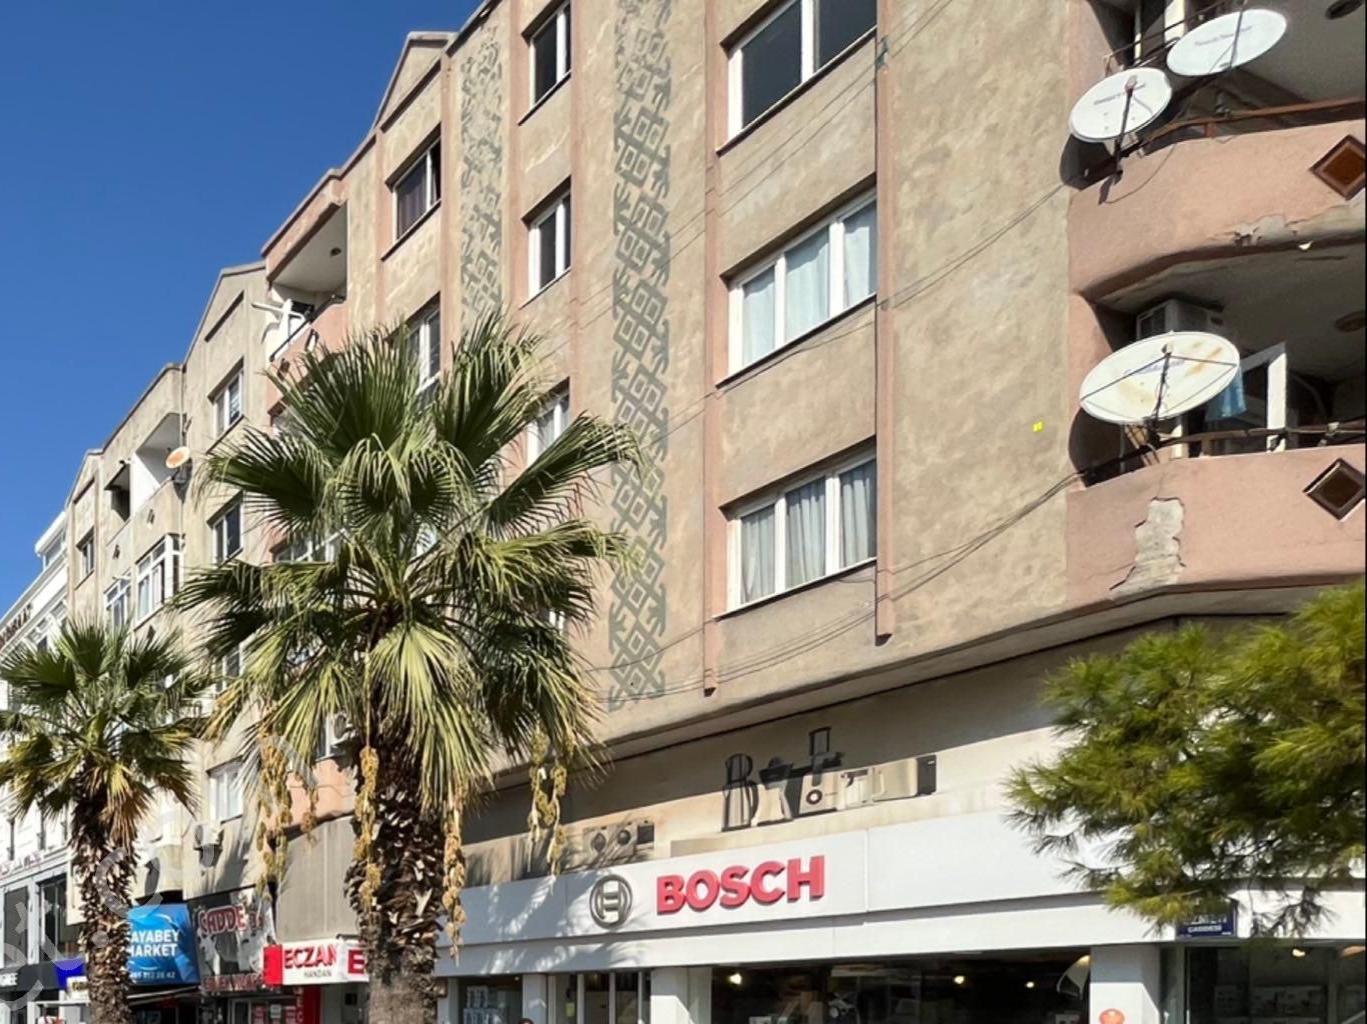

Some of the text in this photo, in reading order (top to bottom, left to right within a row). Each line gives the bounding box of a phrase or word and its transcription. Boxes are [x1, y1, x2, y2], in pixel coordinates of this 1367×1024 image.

[657, 855, 825, 916] BOSCH
[198, 904, 247, 934] CADDE
[128, 929, 180, 943] AYABEY
